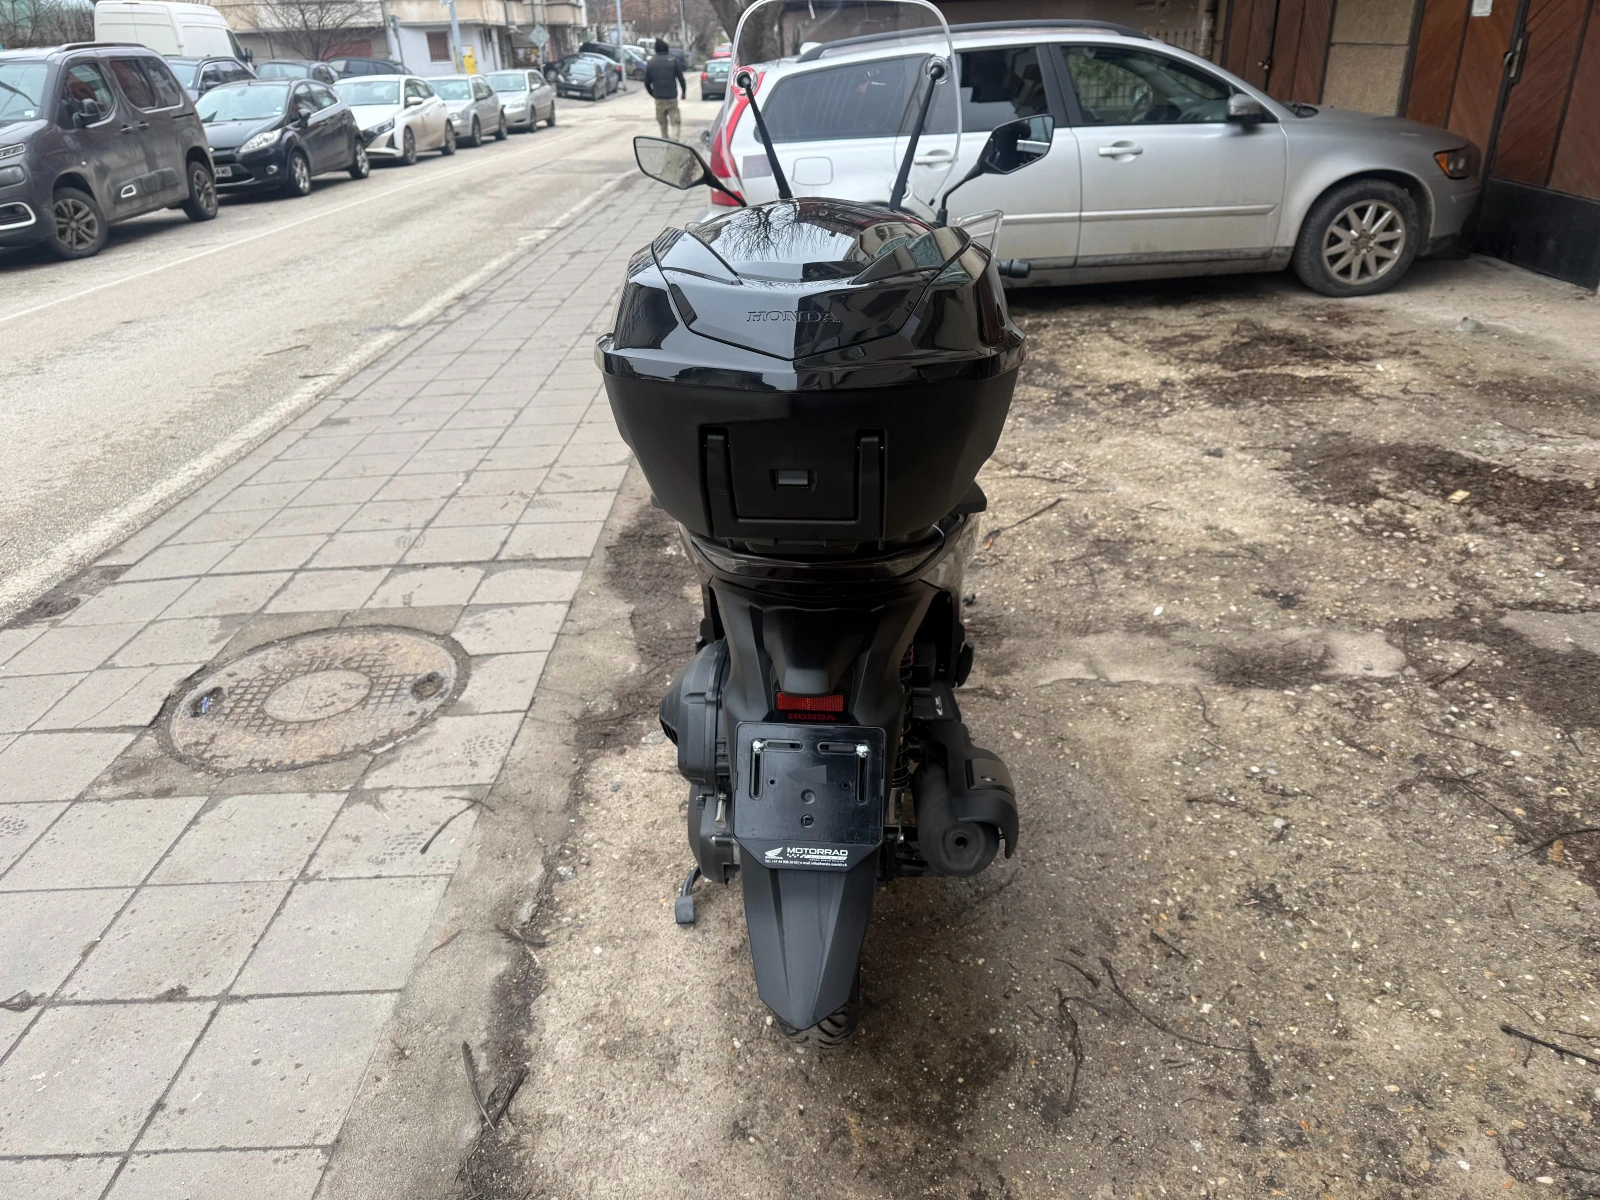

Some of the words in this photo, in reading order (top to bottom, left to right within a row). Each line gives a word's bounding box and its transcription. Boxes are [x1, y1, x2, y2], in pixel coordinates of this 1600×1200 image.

[747, 311, 840, 322] HONDA
[787, 713, 836, 721] HONDA
[787, 847, 848, 856] MOTORRAD
